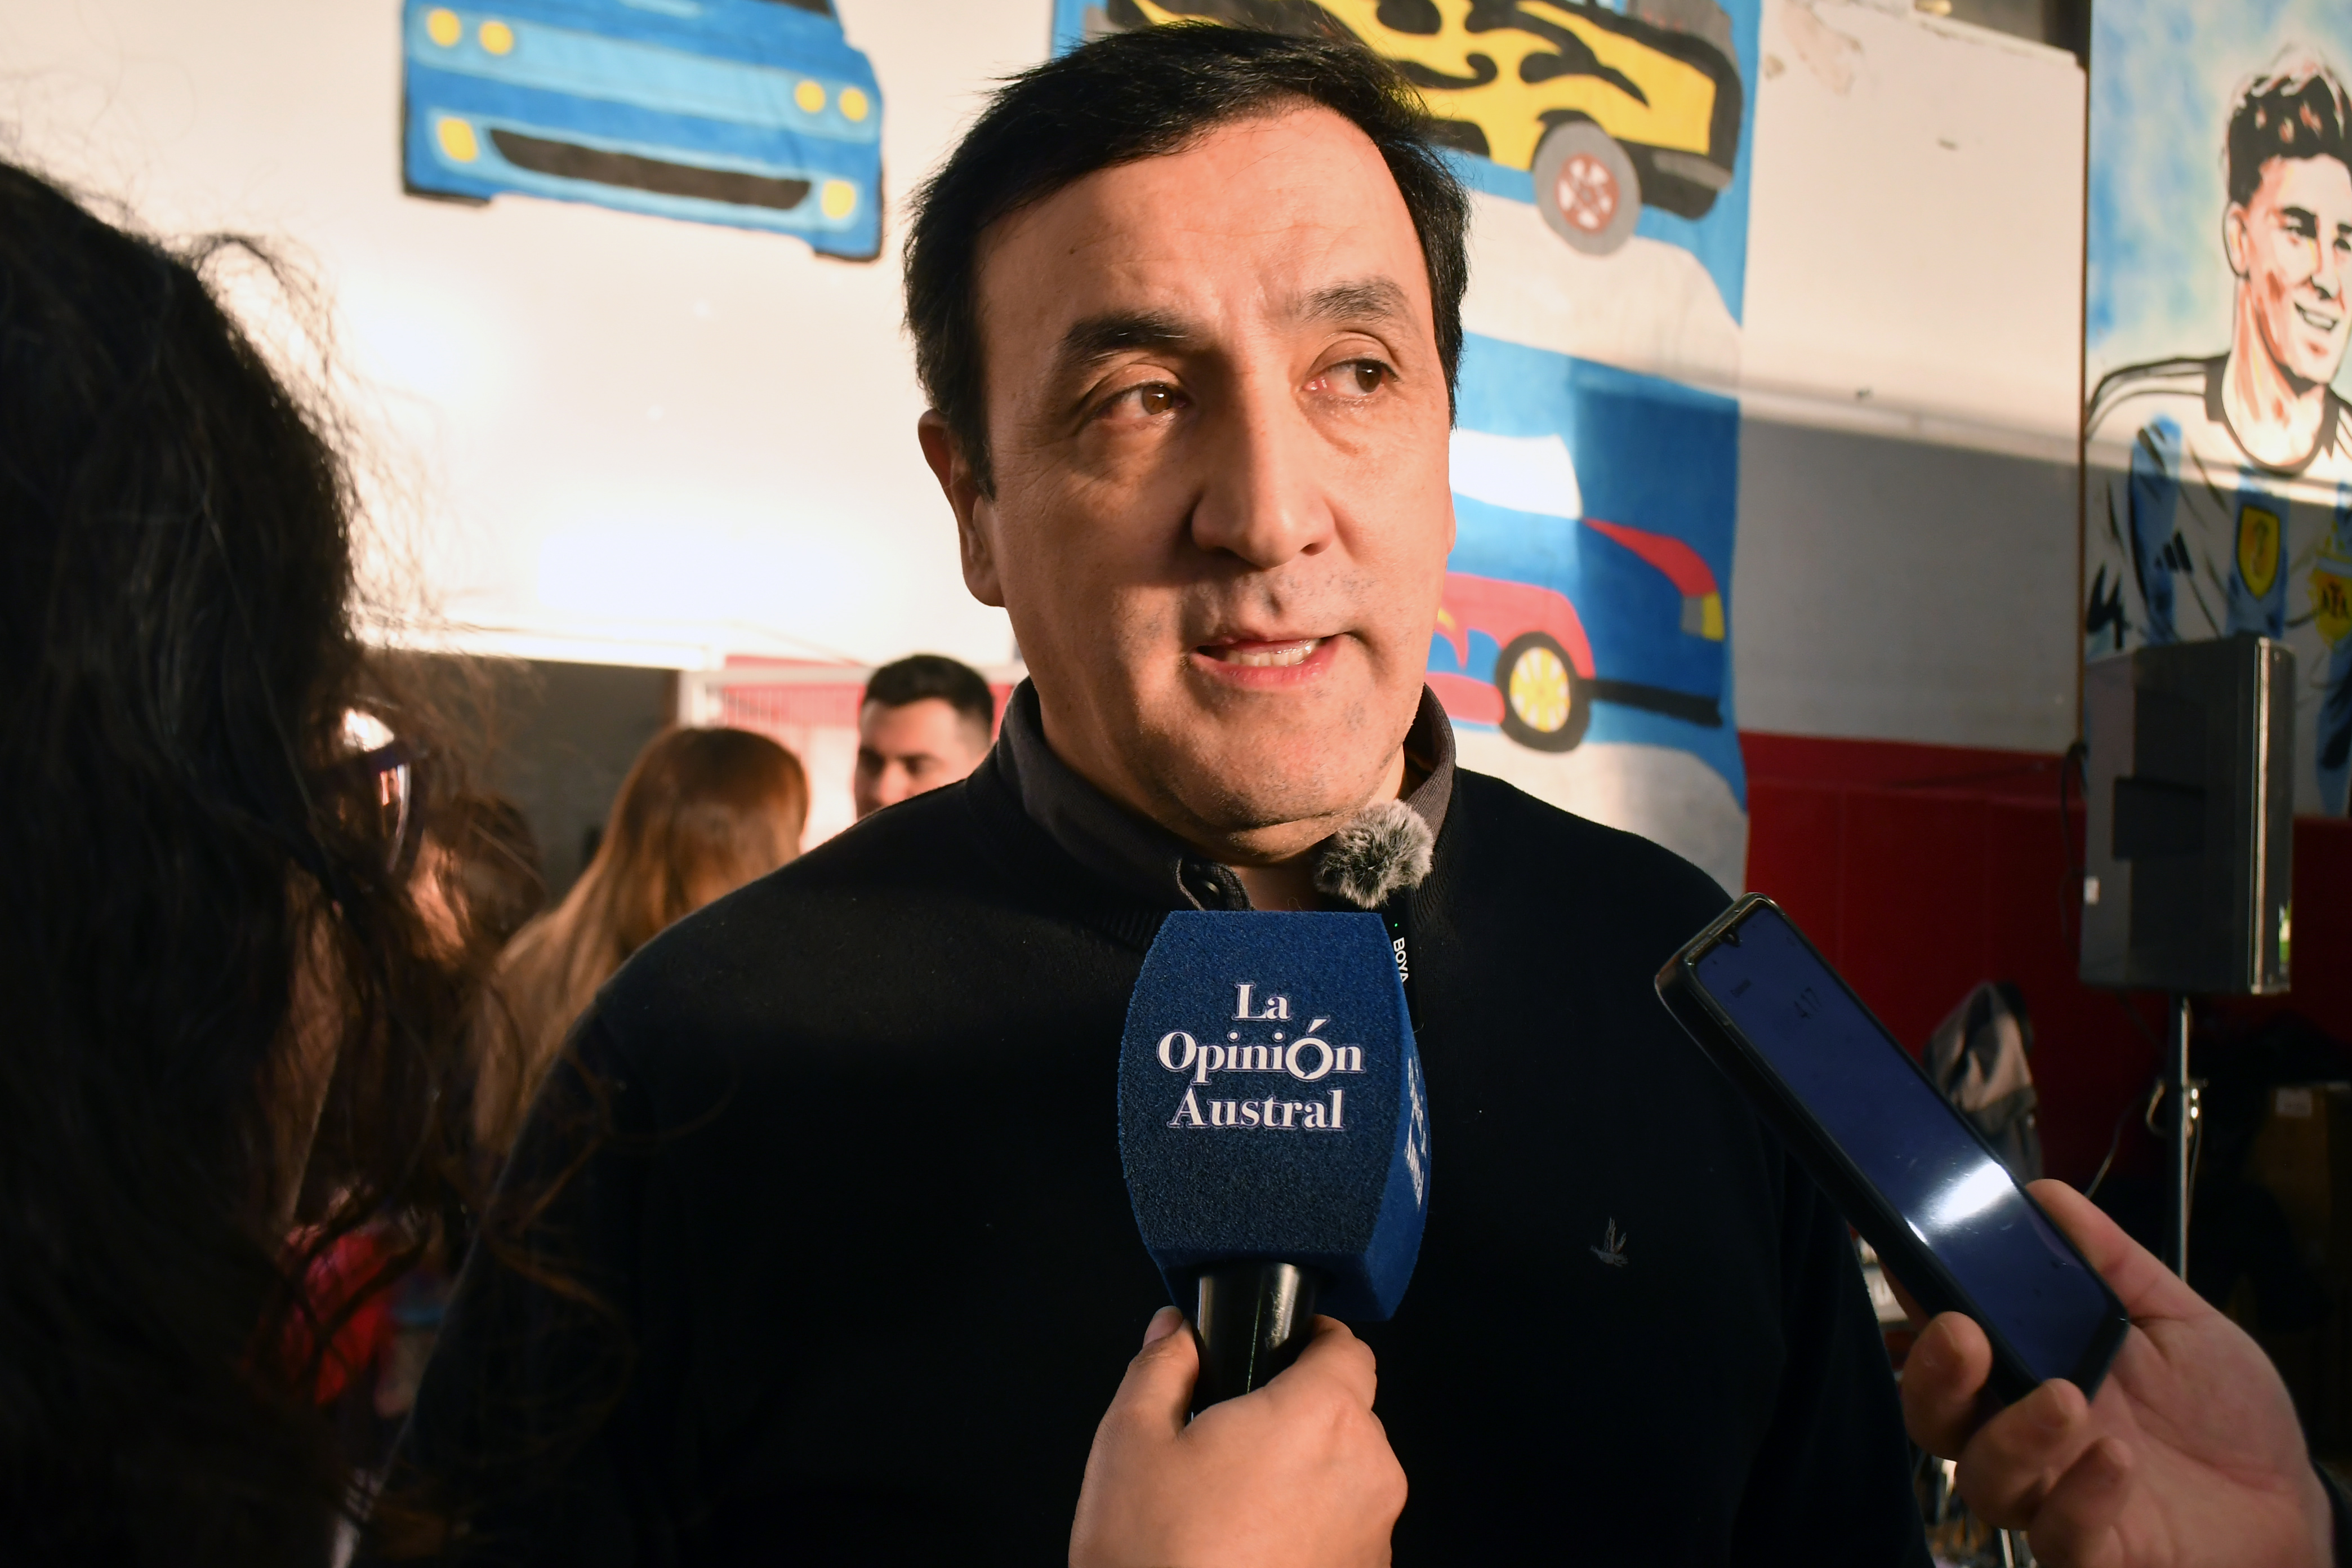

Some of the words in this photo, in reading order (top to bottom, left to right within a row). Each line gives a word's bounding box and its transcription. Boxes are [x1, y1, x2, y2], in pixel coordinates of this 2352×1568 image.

[1393, 937, 1409, 983] BOYA
[1232, 983, 1291, 1020] La
[1167, 1085, 1345, 1129] Austral
